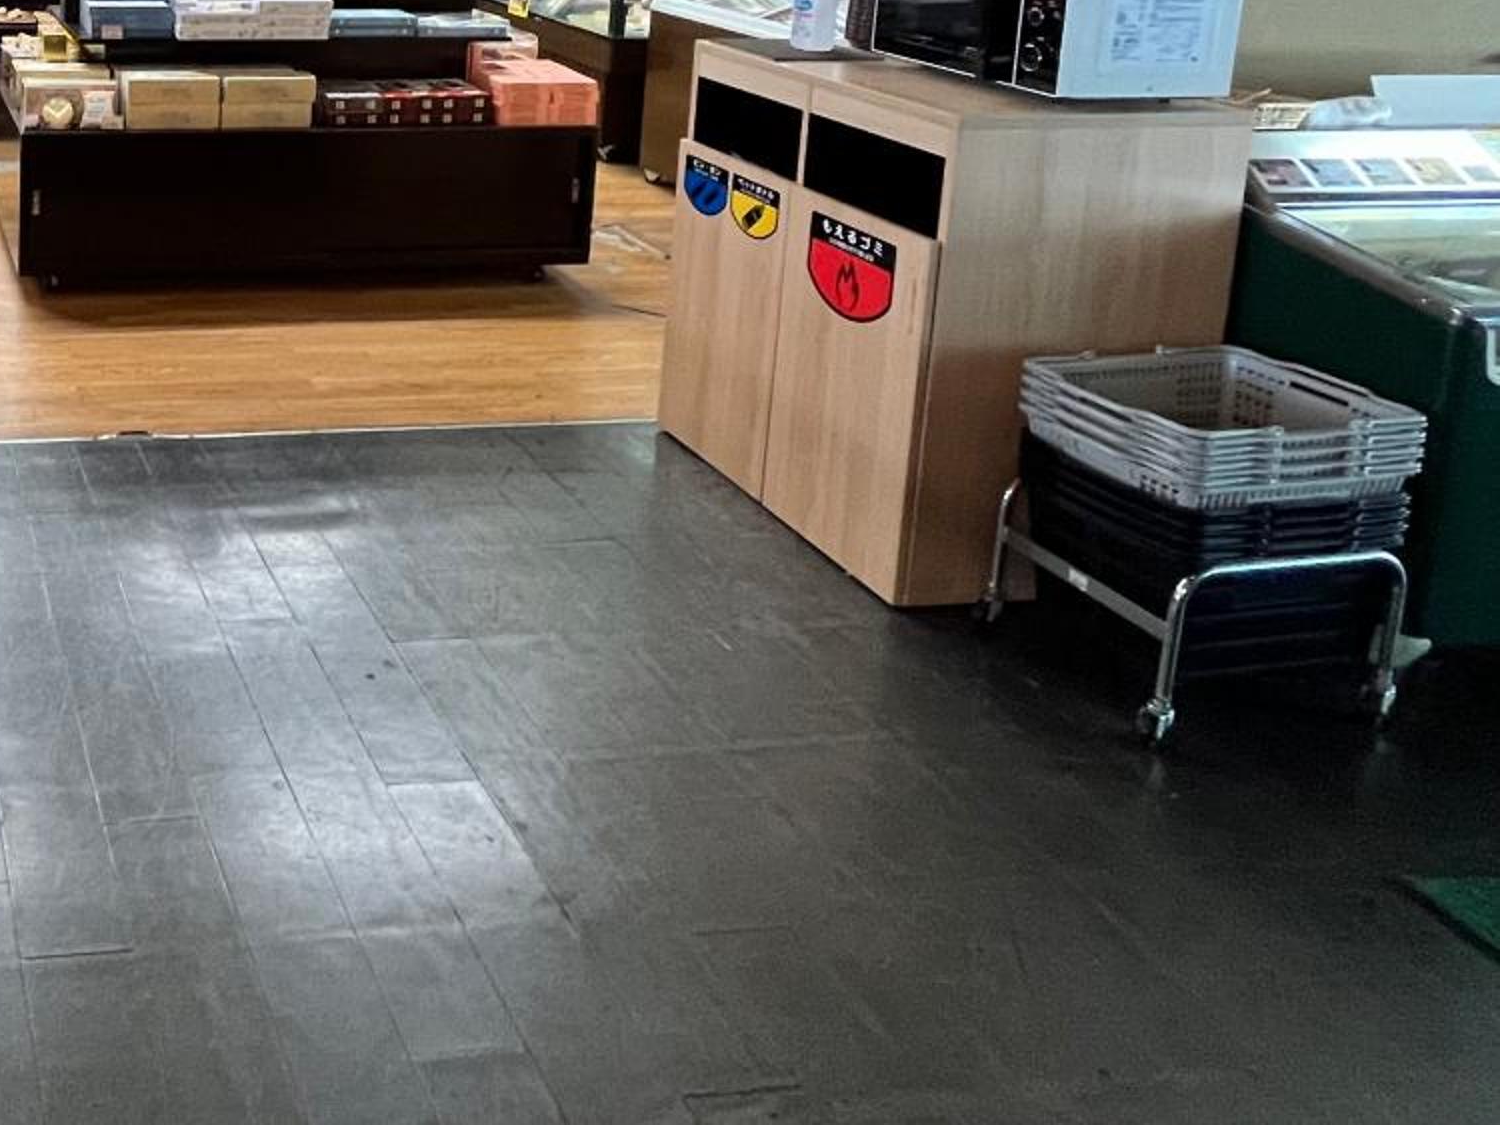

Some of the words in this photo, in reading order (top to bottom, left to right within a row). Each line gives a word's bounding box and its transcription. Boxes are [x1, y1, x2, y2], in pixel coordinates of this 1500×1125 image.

[822, 218, 884, 256] もえるゴミ
